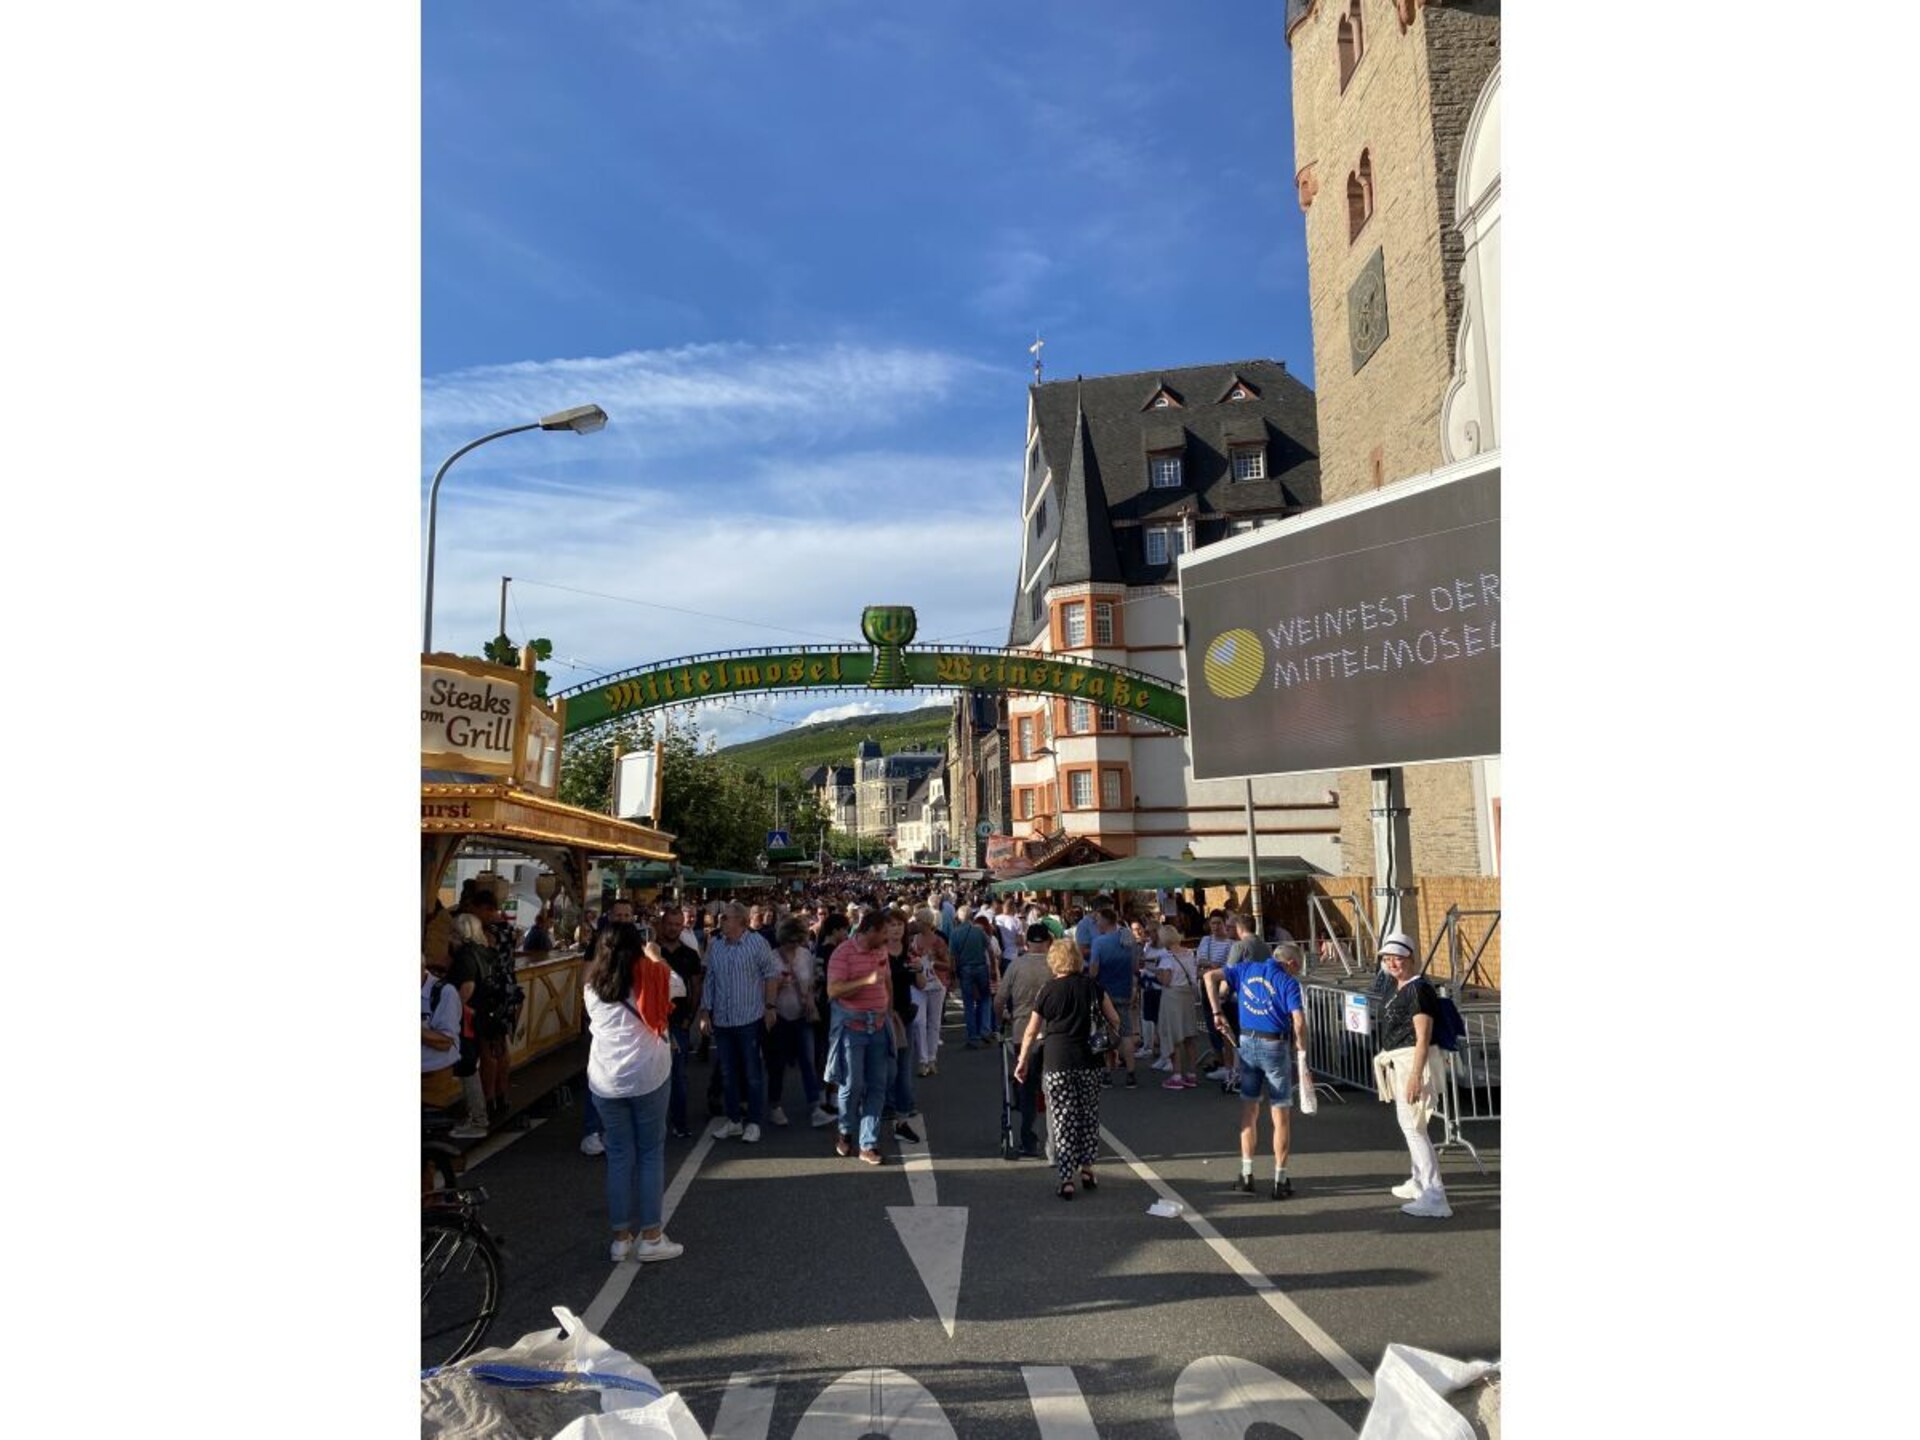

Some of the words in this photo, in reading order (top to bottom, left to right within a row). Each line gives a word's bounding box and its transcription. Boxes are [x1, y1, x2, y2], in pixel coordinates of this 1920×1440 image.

[1267, 594, 1416, 649] WEINFEST
[1431, 573, 1500, 612] DER
[605, 655, 843, 712] Mittelmosel
[933, 654, 1150, 707] Weinstraße
[1274, 621, 1500, 689] MITTELMOSEL
[430, 678, 511, 716] Steaks
[446, 715, 512, 752] Grill
